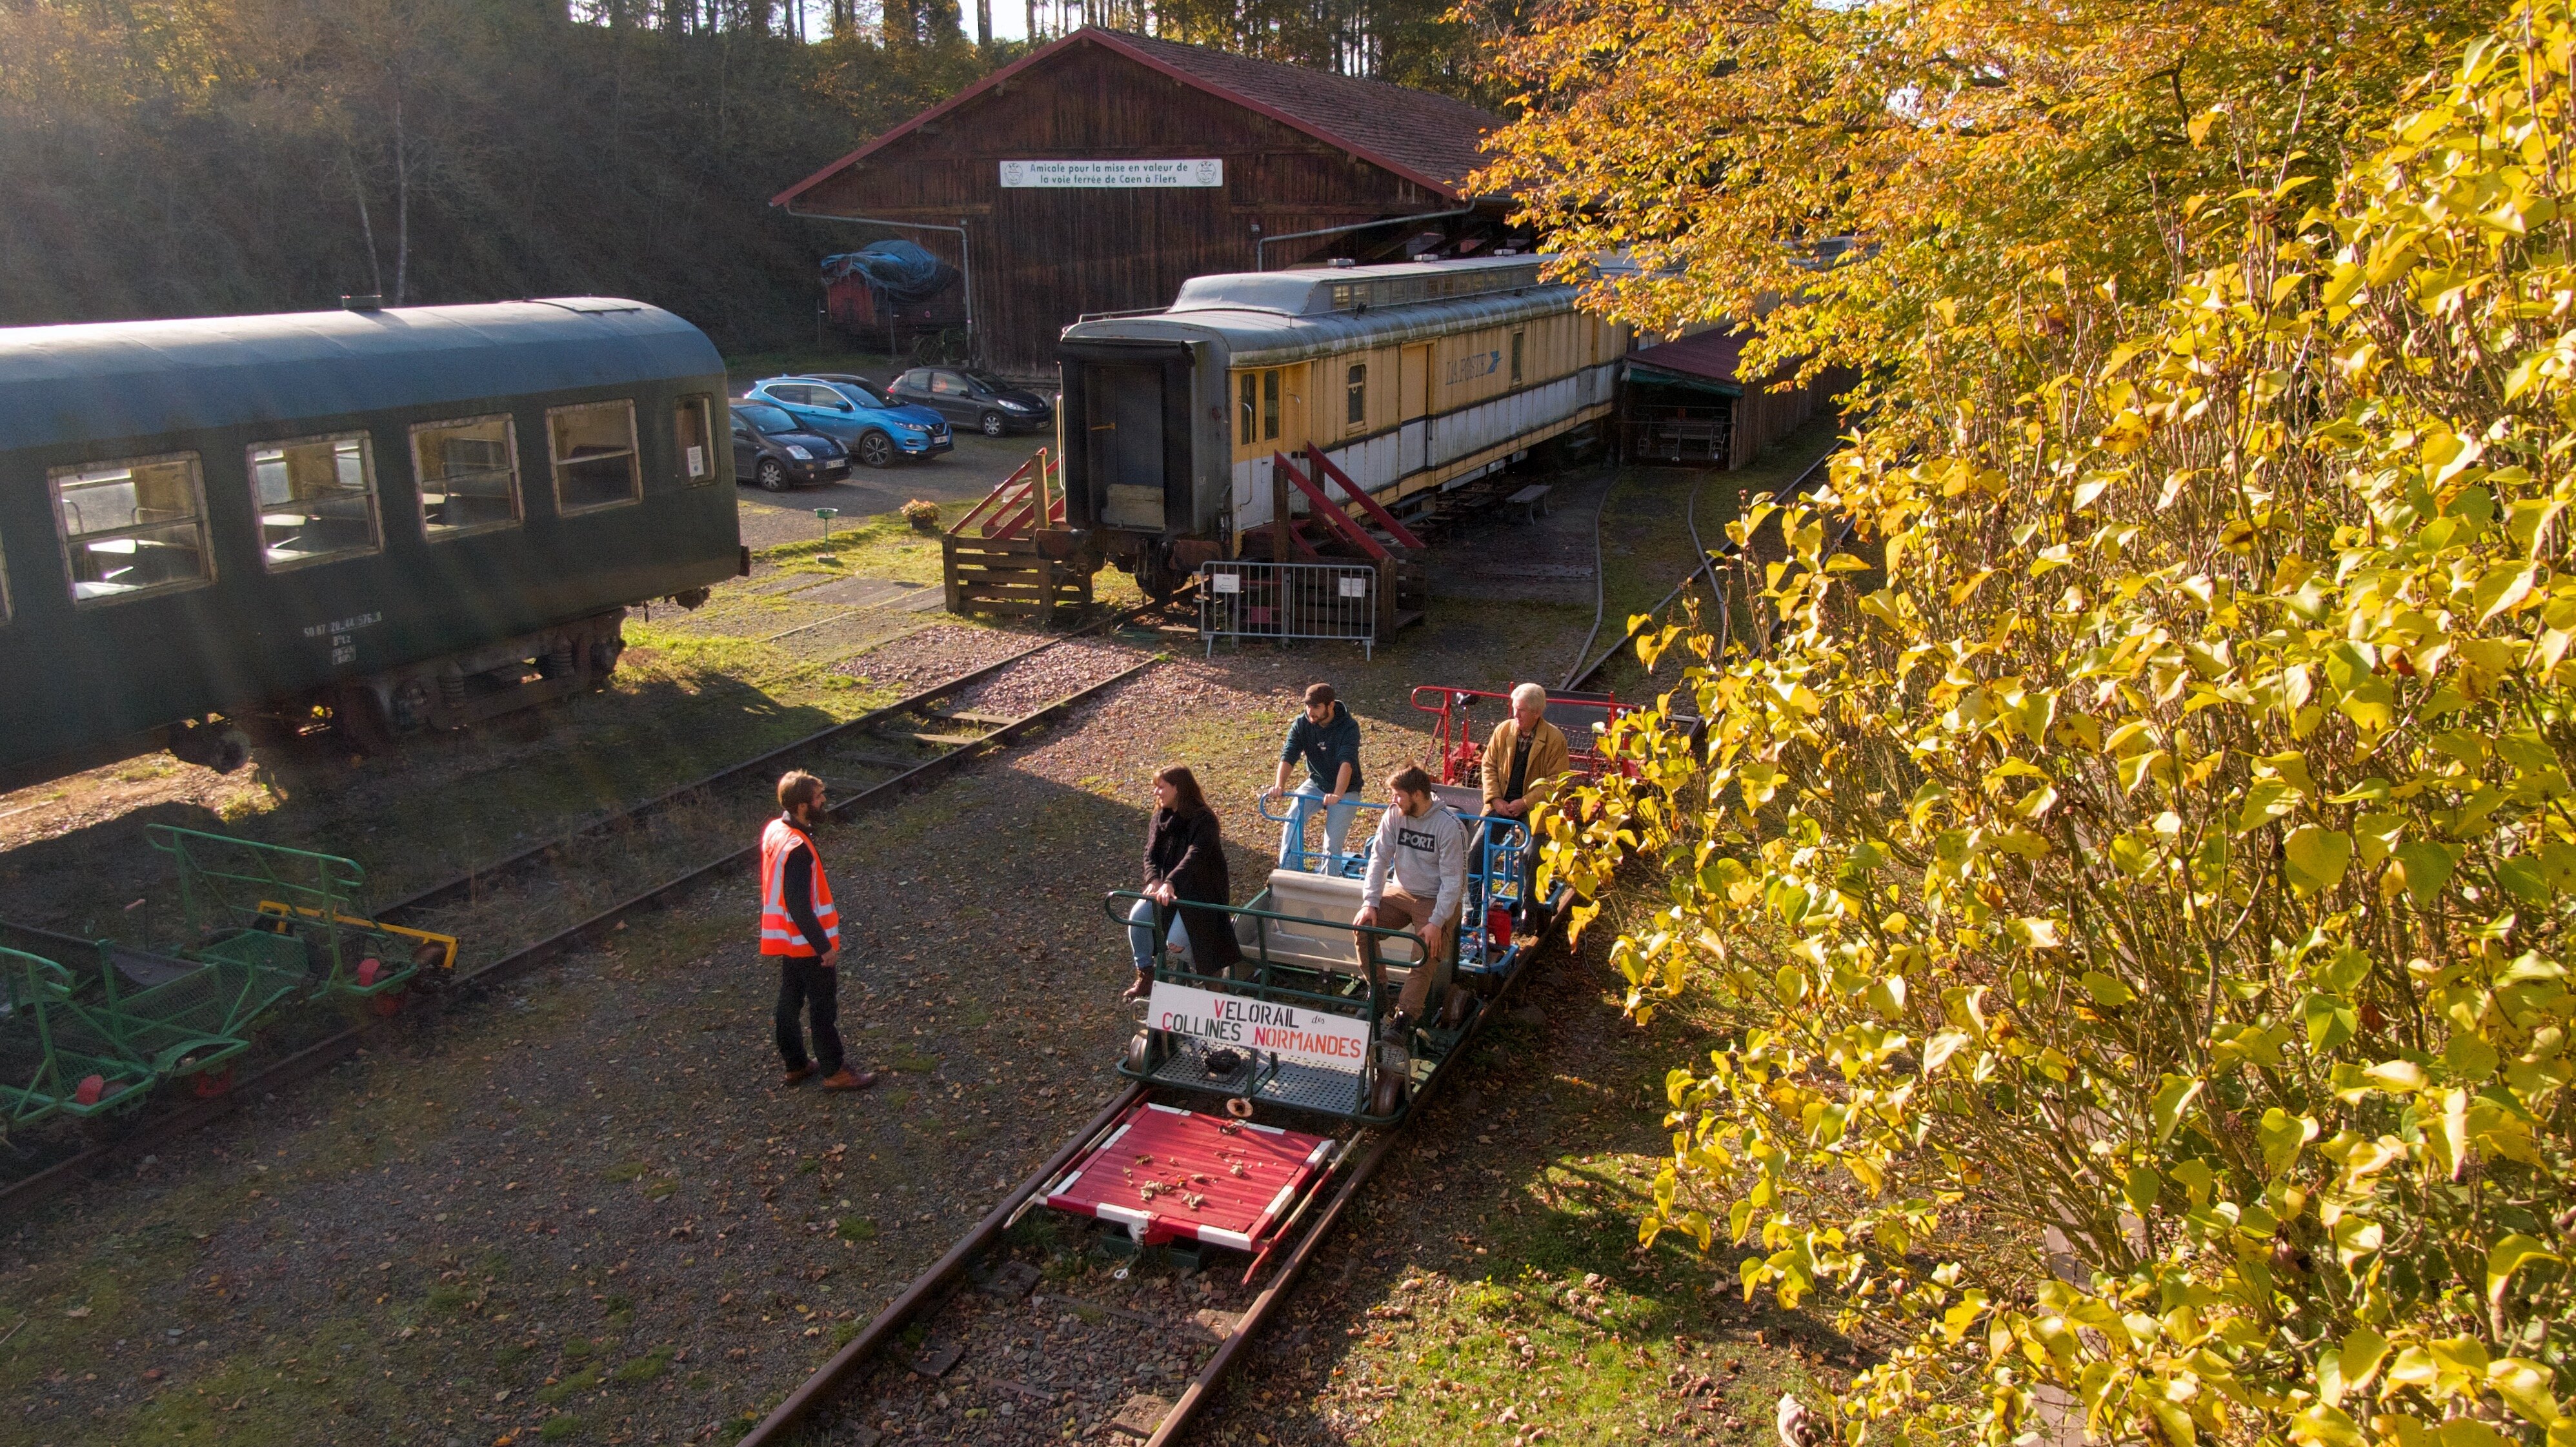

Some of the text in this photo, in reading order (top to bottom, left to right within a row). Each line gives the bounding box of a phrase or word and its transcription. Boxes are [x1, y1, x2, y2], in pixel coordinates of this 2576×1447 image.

[1031, 163, 1065, 172] Amicale
[1069, 164, 1089, 174] pour
[1092, 163, 1101, 172] la
[1105, 163, 1125, 172] mise
[1143, 163, 1172, 172] valeur
[1176, 163, 1188, 171] de
[1040, 174, 1177, 183] la voie ferrée de Caen à Flers
[1459, 353, 1487, 382] POSTE
[1214, 998, 1325, 1028] VELORAIL des
[1162, 1012, 1361, 1058] COLLINES NORMANDES
